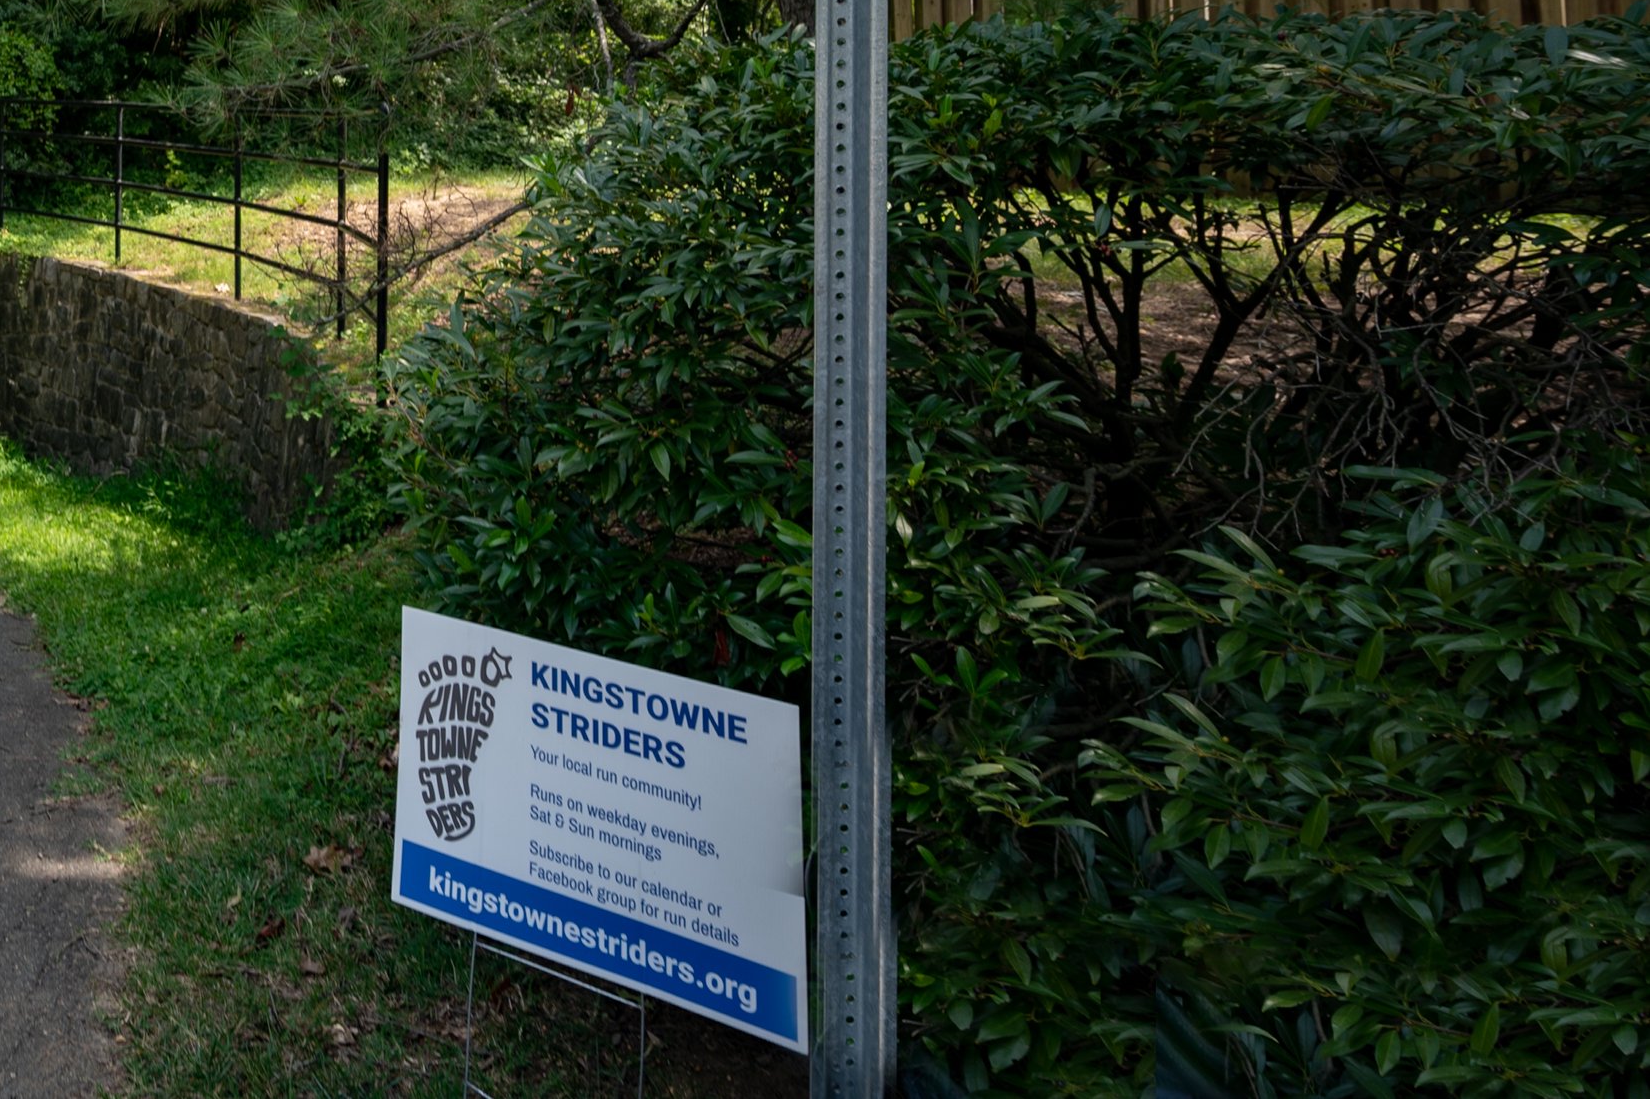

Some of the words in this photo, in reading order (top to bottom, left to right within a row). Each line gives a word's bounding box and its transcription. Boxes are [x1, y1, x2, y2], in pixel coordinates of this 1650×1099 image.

[417, 682, 496, 728] KINGS
[531, 661, 748, 744] KINGSTOWNE
[531, 702, 686, 769] STRIDERS
[416, 725, 489, 763] TOWNE
[418, 763, 472, 804] STRI
[530, 744, 559, 766] Your
[562, 753, 592, 777] local
[596, 768, 618, 785] run
[622, 775, 702, 812] community!
[425, 800, 476, 842] DERS
[530, 783, 563, 807] Runs
[567, 798, 583, 813] on
[587, 804, 647, 836] weekday
[651, 825, 720, 859] evenings,
[530, 805, 552, 825] Sat
[555, 814, 565, 829] &
[569, 817, 595, 839] Sun
[599, 830, 662, 862] mornings
[529, 840, 594, 875] Subscribe
[598, 864, 610, 880] to
[615, 871, 638, 889] our
[642, 879, 703, 911] calendar
[707, 901, 723, 918] or
[529, 861, 594, 896] Facebook
[598, 887, 636, 912] group
[640, 900, 660, 918] for
[664, 911, 686, 929] run
[691, 917, 739, 947] details
[429, 865, 758, 1014] kingstownestriders.org
